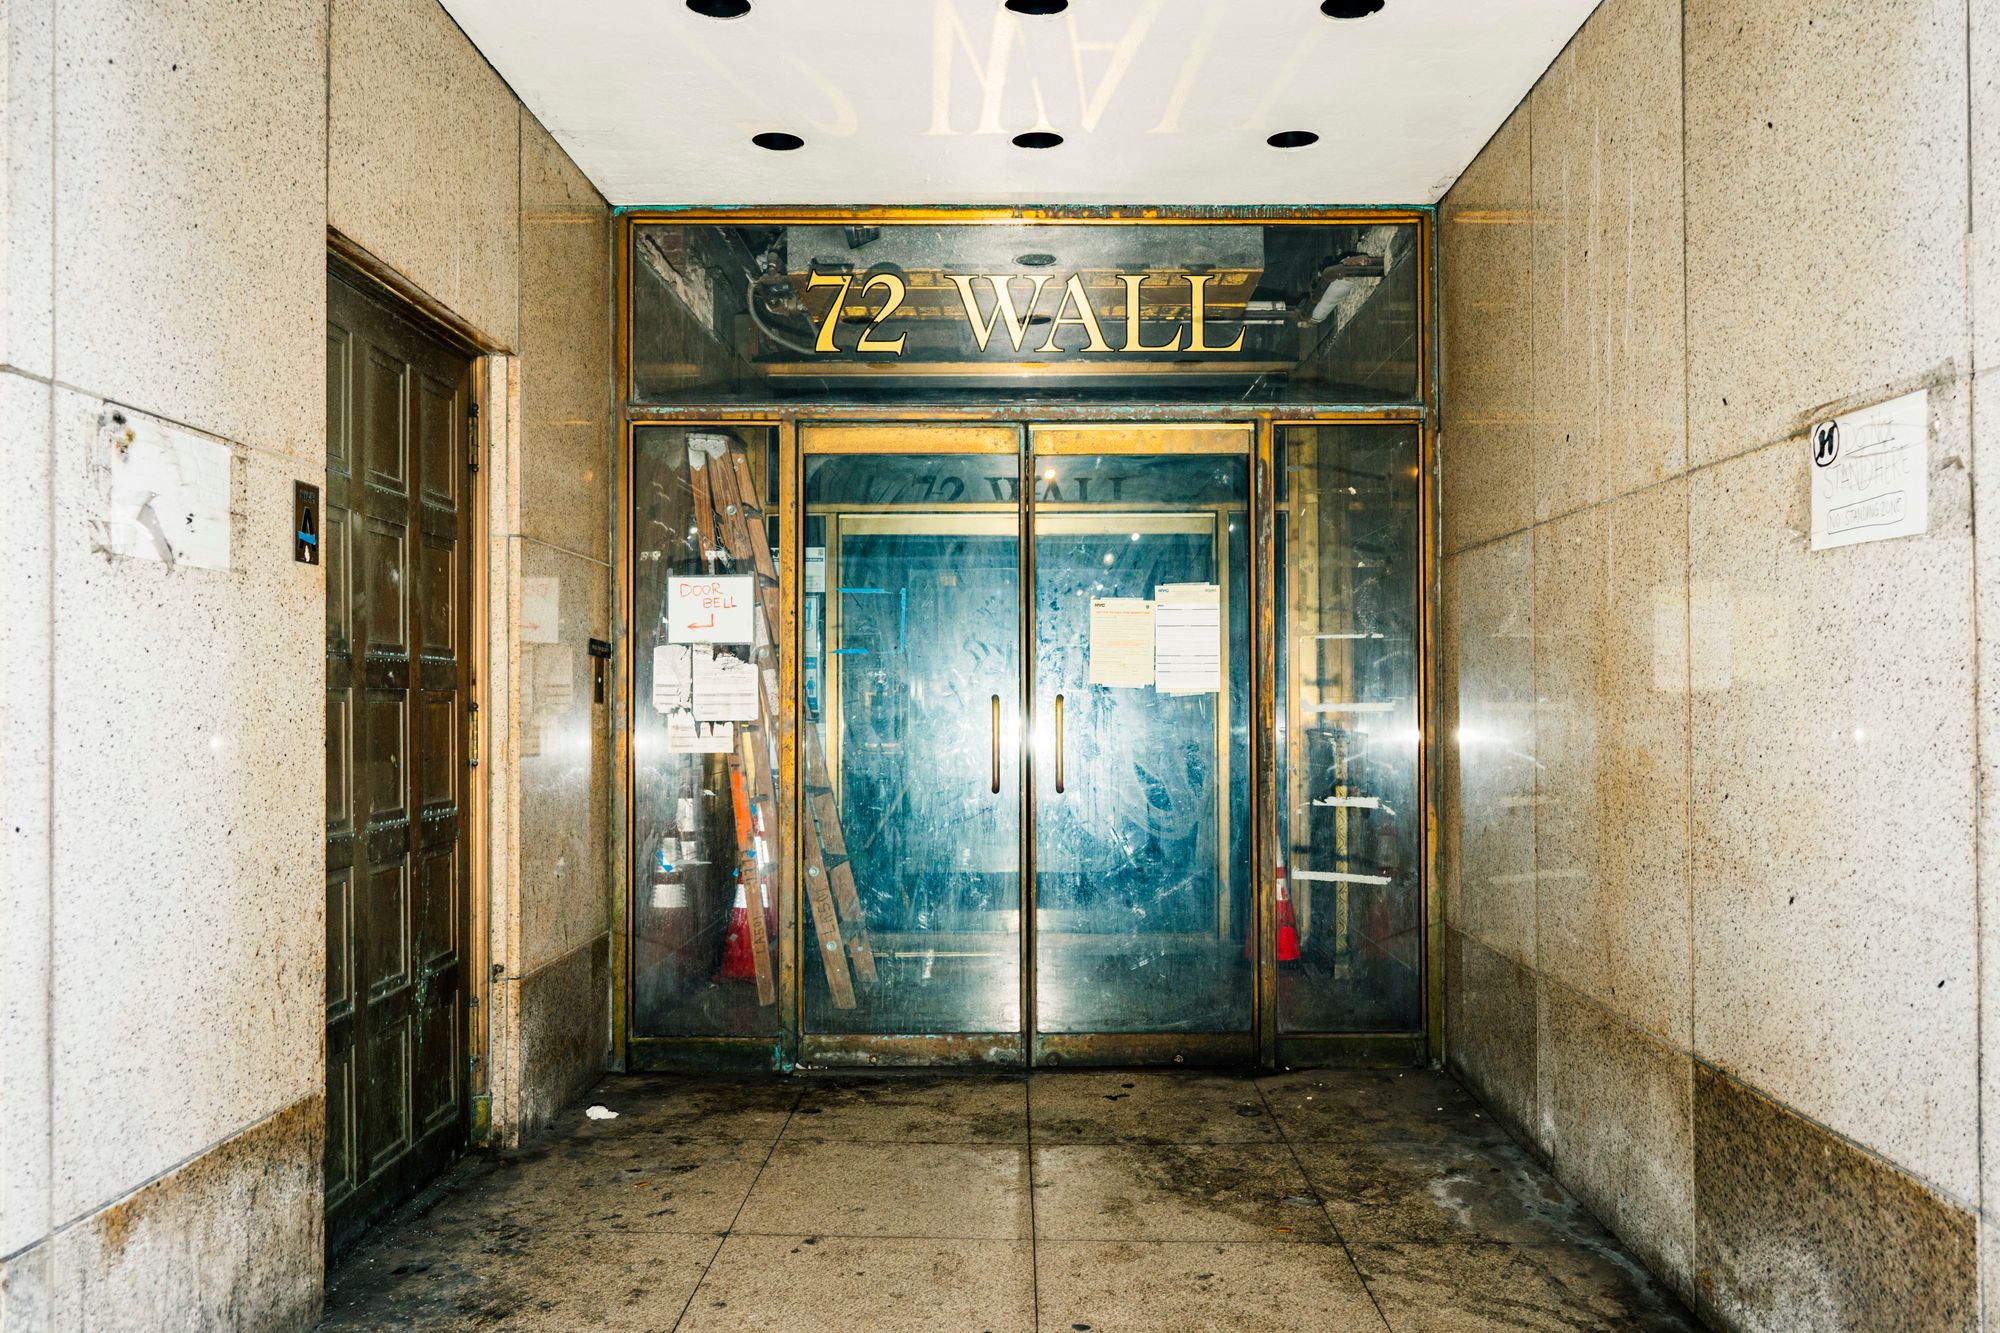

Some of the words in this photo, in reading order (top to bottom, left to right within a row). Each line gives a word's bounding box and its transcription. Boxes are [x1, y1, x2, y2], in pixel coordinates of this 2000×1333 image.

[804, 269, 908, 355] 72
[944, 270, 1247, 355] WALL
[299, 506, 317, 551] A
[680, 583, 724, 597] DOOR
[703, 595, 738, 608] BELL
